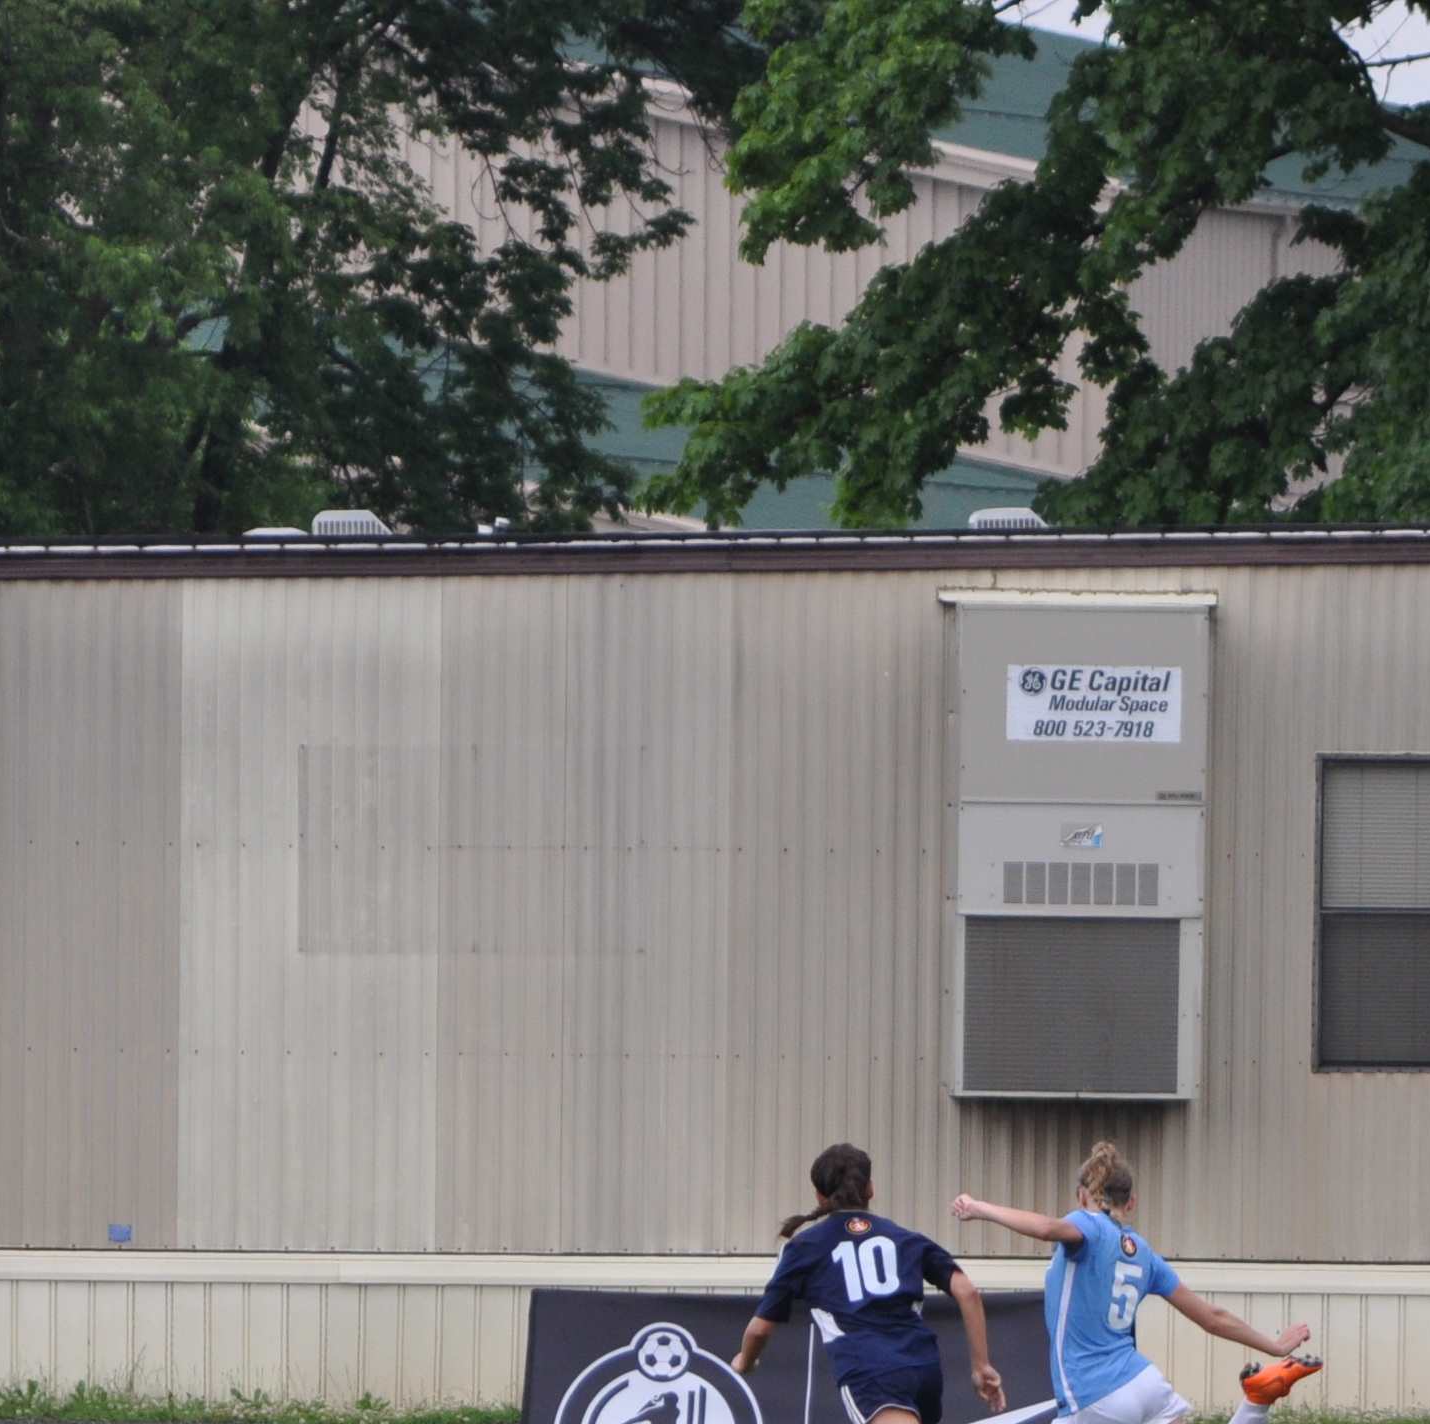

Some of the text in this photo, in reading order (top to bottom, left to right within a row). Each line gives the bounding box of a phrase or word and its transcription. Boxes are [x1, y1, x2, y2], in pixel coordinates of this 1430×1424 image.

[1050, 669, 1172, 697] GE Capital
[1048, 694, 1169, 715] Modular Space
[1032, 719, 1155, 738] 800 523-7918
[831, 1235, 900, 1302] 10
[1107, 1260, 1143, 1330] 5
